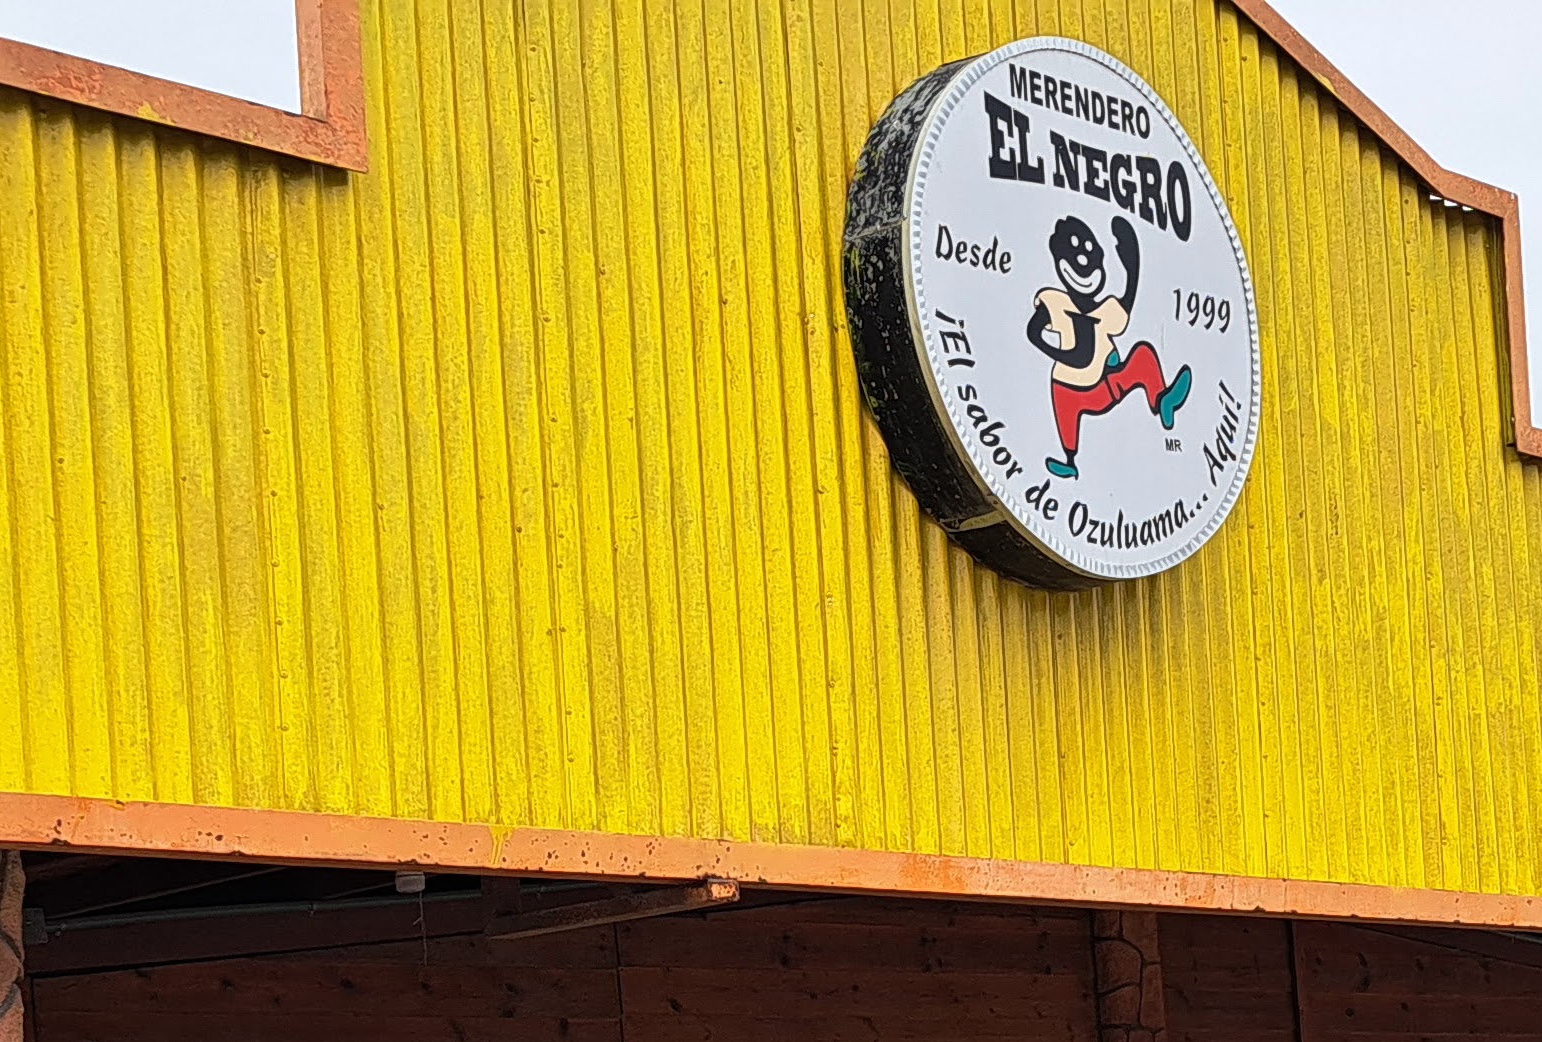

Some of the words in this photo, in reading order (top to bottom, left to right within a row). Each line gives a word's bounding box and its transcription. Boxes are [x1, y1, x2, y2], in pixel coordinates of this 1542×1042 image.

[1009, 63, 1150, 139] MERENDERO
[984, 90, 1045, 185] EL
[1050, 129, 1191, 242] NEGRO
[935, 223, 1011, 274] Desde
[1173, 288, 1231, 333] 1999
[957, 384, 1022, 480] sabor
[1025, 479, 1059, 520] de
[1068, 493, 1208, 549] Ozuluama...
[1203, 380, 1242, 486] Aquí!
[1165, 438, 1182, 452] MR
